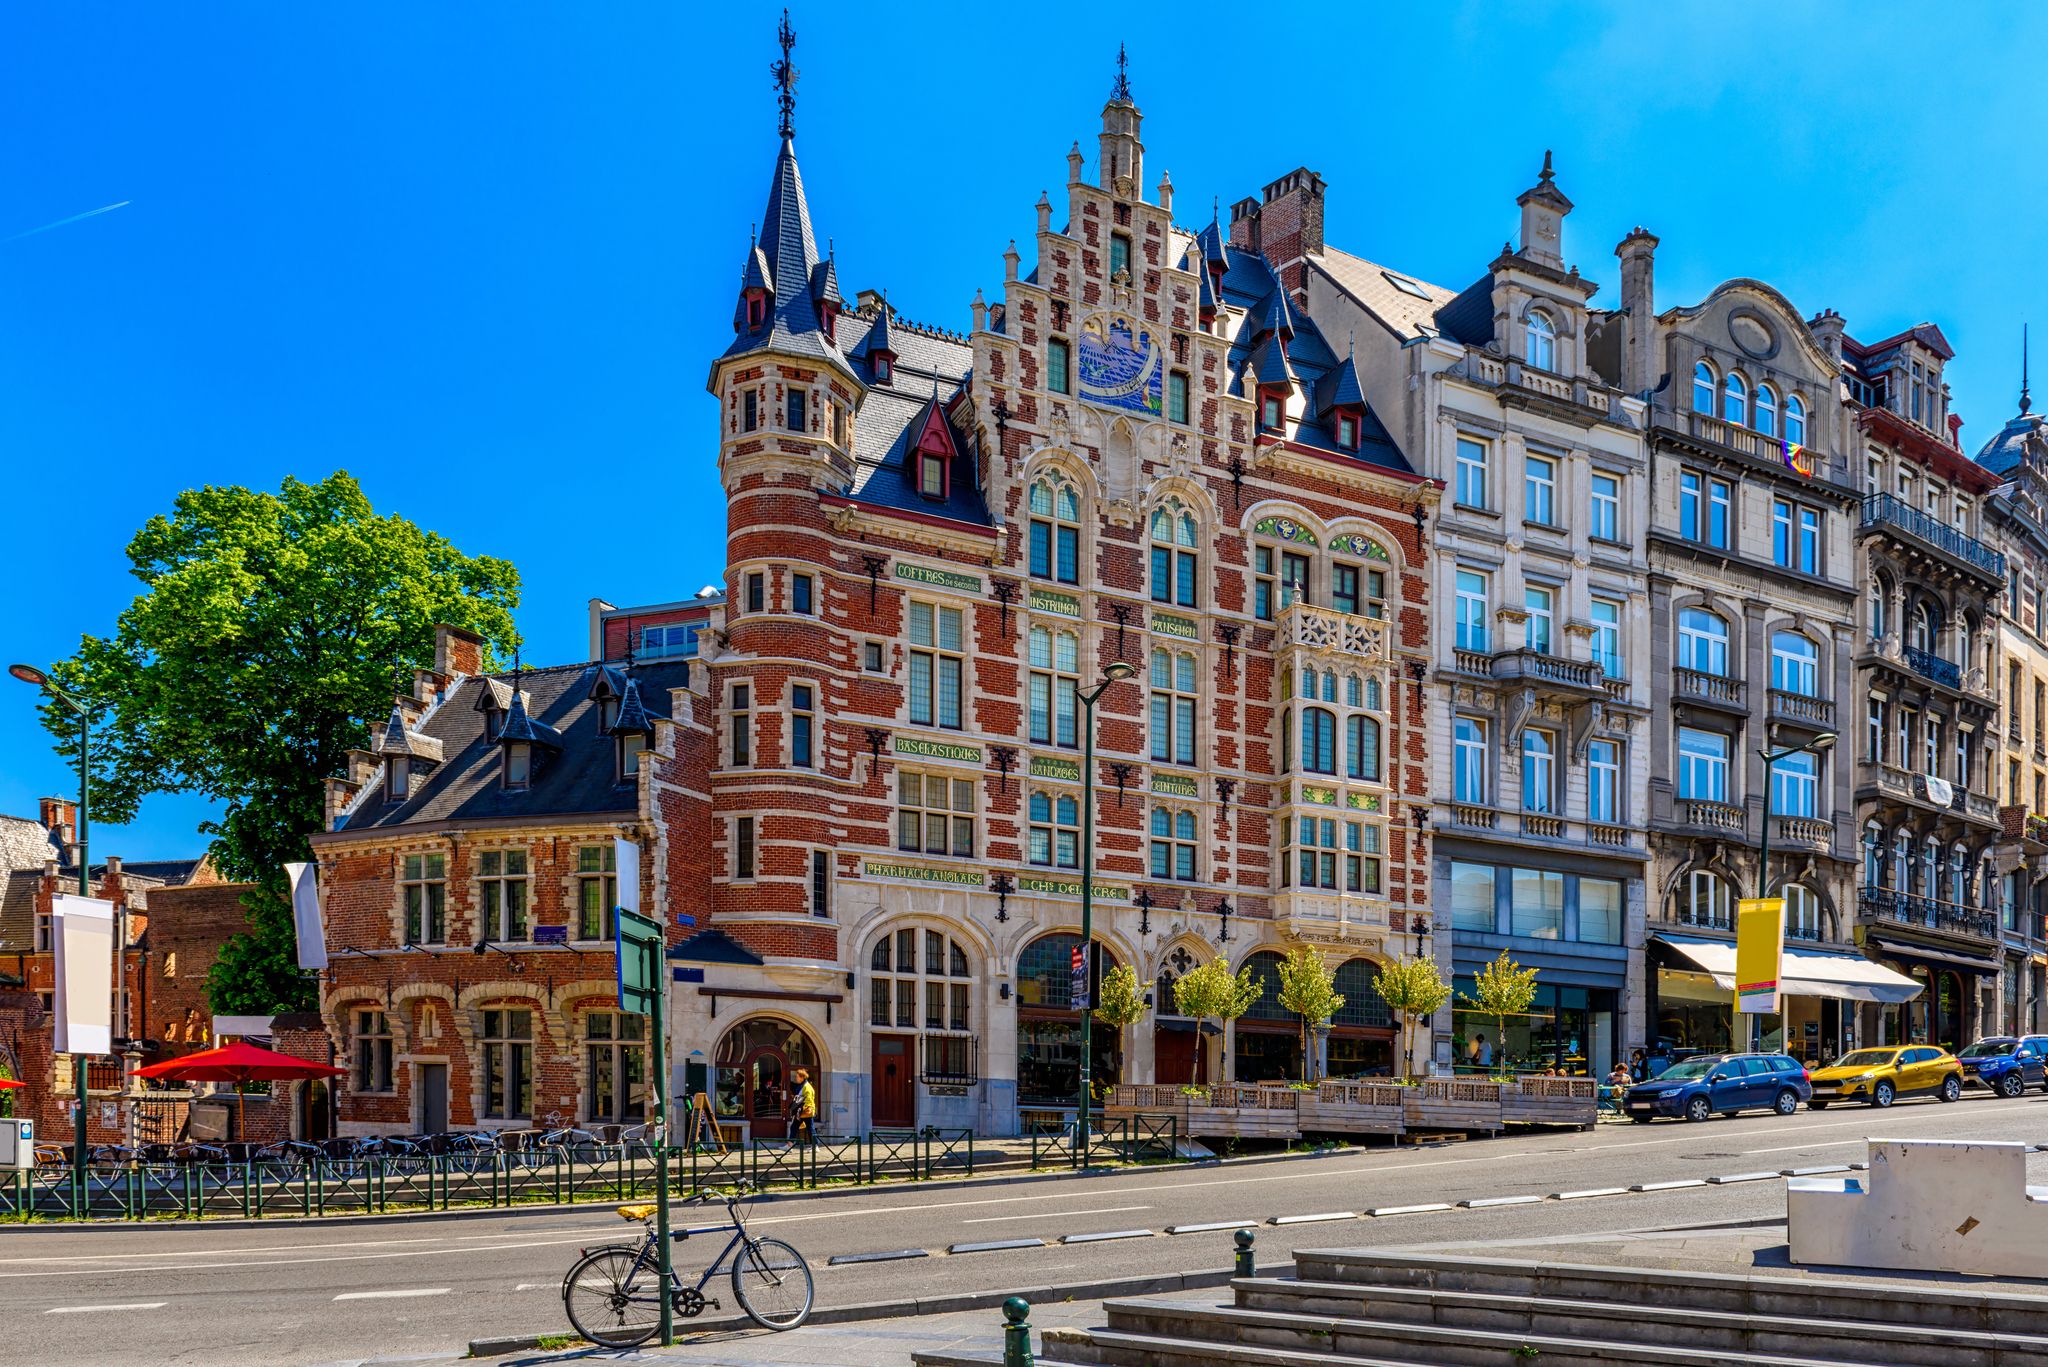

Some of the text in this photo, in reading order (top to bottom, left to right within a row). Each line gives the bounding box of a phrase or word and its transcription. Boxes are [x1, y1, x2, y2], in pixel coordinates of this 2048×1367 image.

[898, 565, 979, 590] COFFRES DE SECOURS
[896, 738, 980, 761] BAS ELASTIQUES
[1030, 763, 1079, 780] BANDAGES
[1151, 780, 1197, 796] CEINTURES
[866, 863, 983, 885] PHARMACIE ANGLAISE
[1058, 883, 1117, 898] DELCRE
